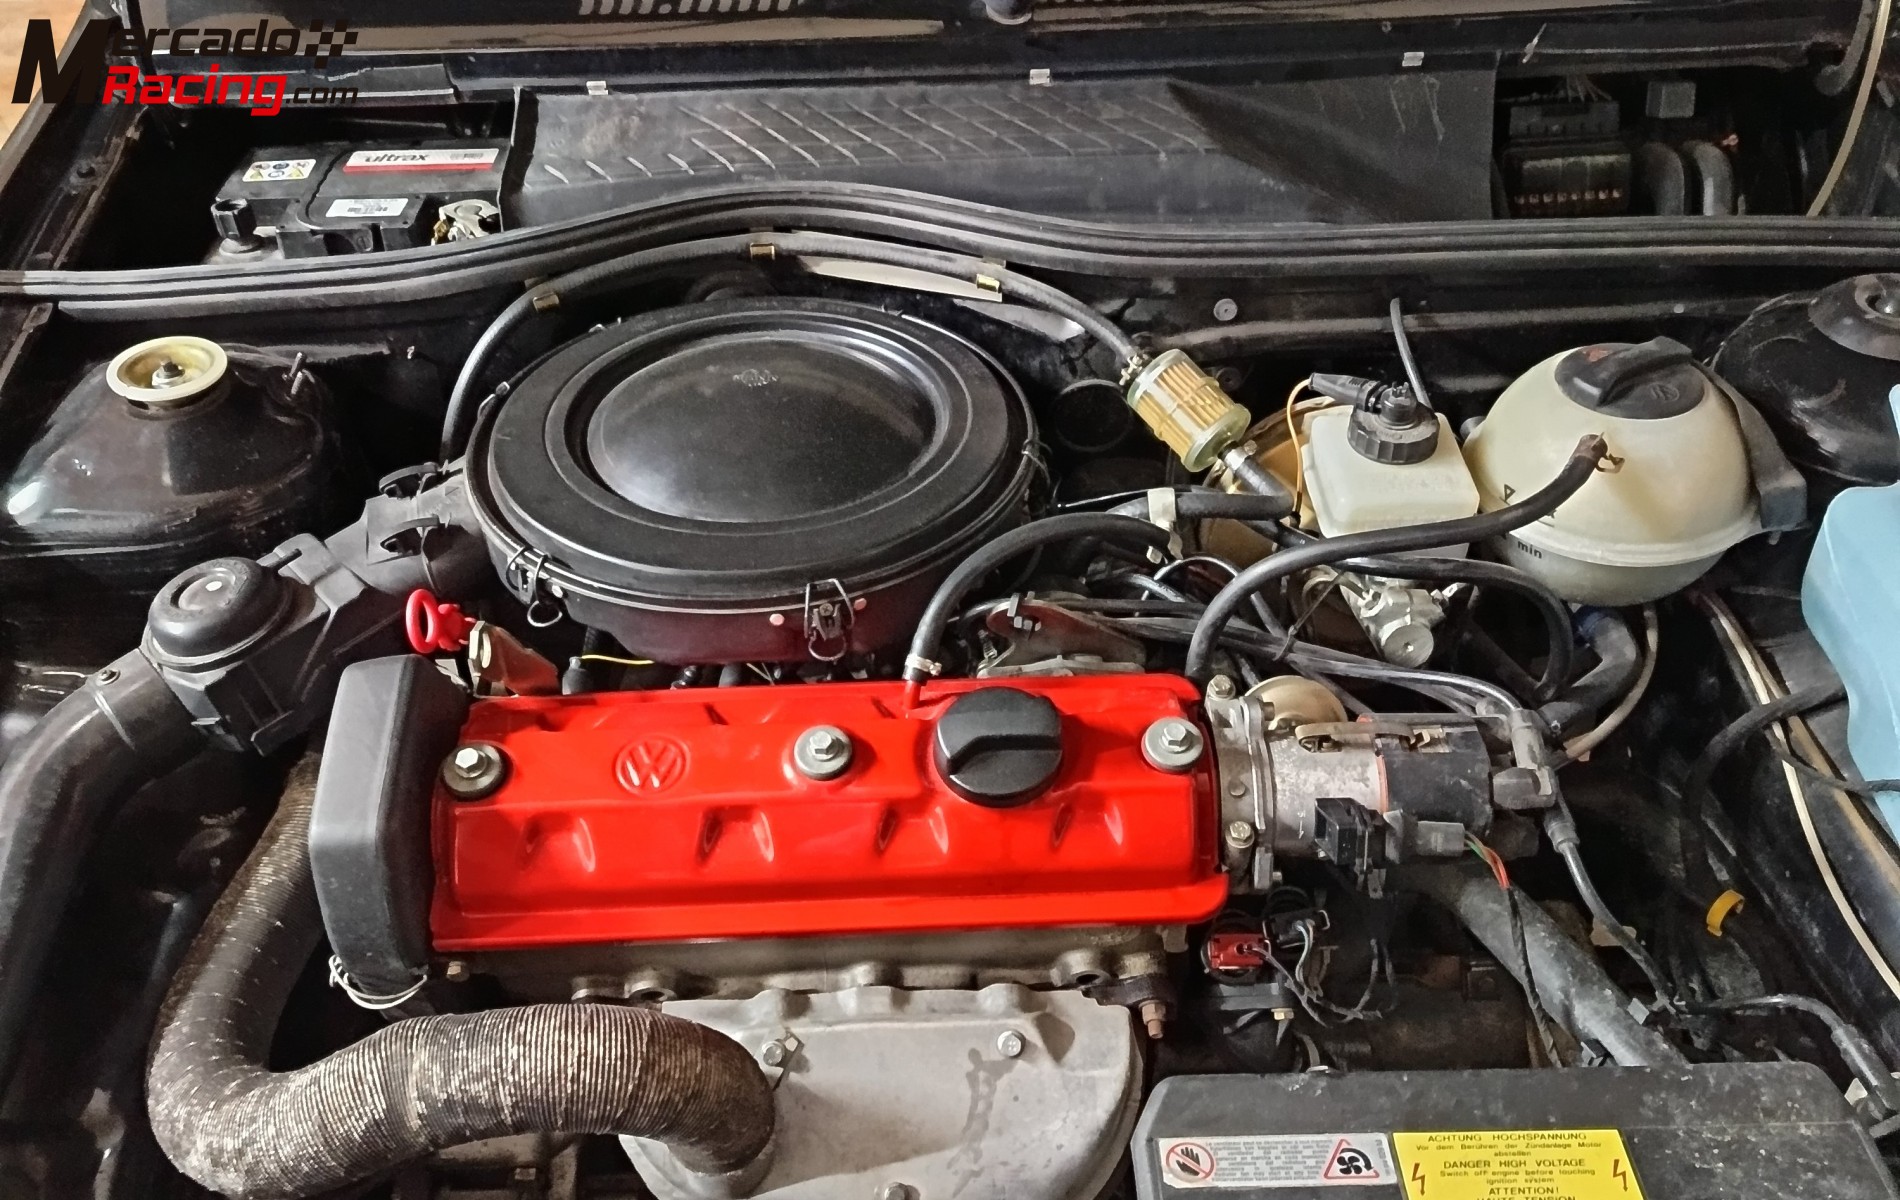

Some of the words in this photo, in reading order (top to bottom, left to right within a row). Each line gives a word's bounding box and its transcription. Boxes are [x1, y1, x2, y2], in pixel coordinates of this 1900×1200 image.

[364, 153, 430, 163] ultrax
[1517, 541, 1542, 559] min
[1428, 1134, 1482, 1142] ACHTUNG
[1492, 1132, 1587, 1141] HOCHSPANNUNG
[1443, 1160, 1491, 1169] DANGER
[1499, 1159, 1527, 1168] HIGH
[1535, 1158, 1586, 1167] VOLTAGE
[1488, 1186, 1559, 1196] ATTENTION!
